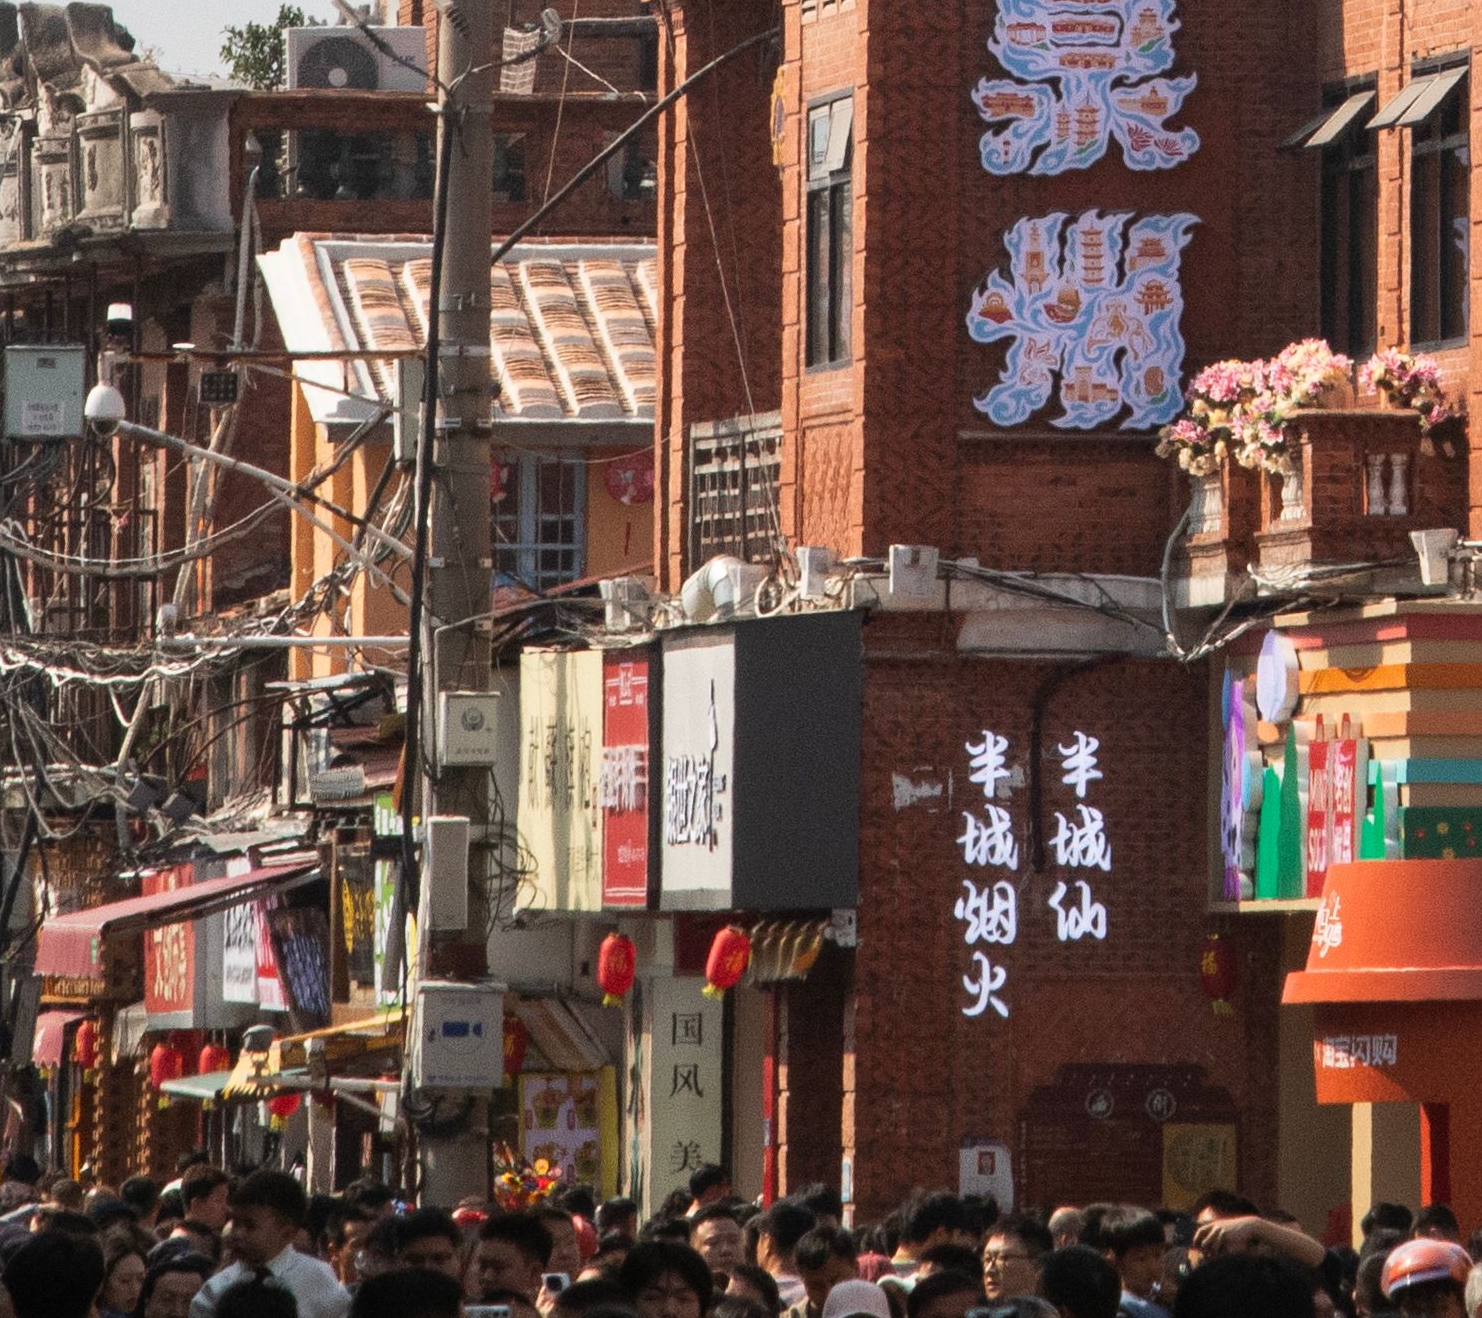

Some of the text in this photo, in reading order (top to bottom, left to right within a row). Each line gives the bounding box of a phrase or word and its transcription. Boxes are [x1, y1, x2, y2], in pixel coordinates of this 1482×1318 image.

[955, 730, 1018, 1018] 半城烟火
[1049, 731, 1111, 942] 半城仙
